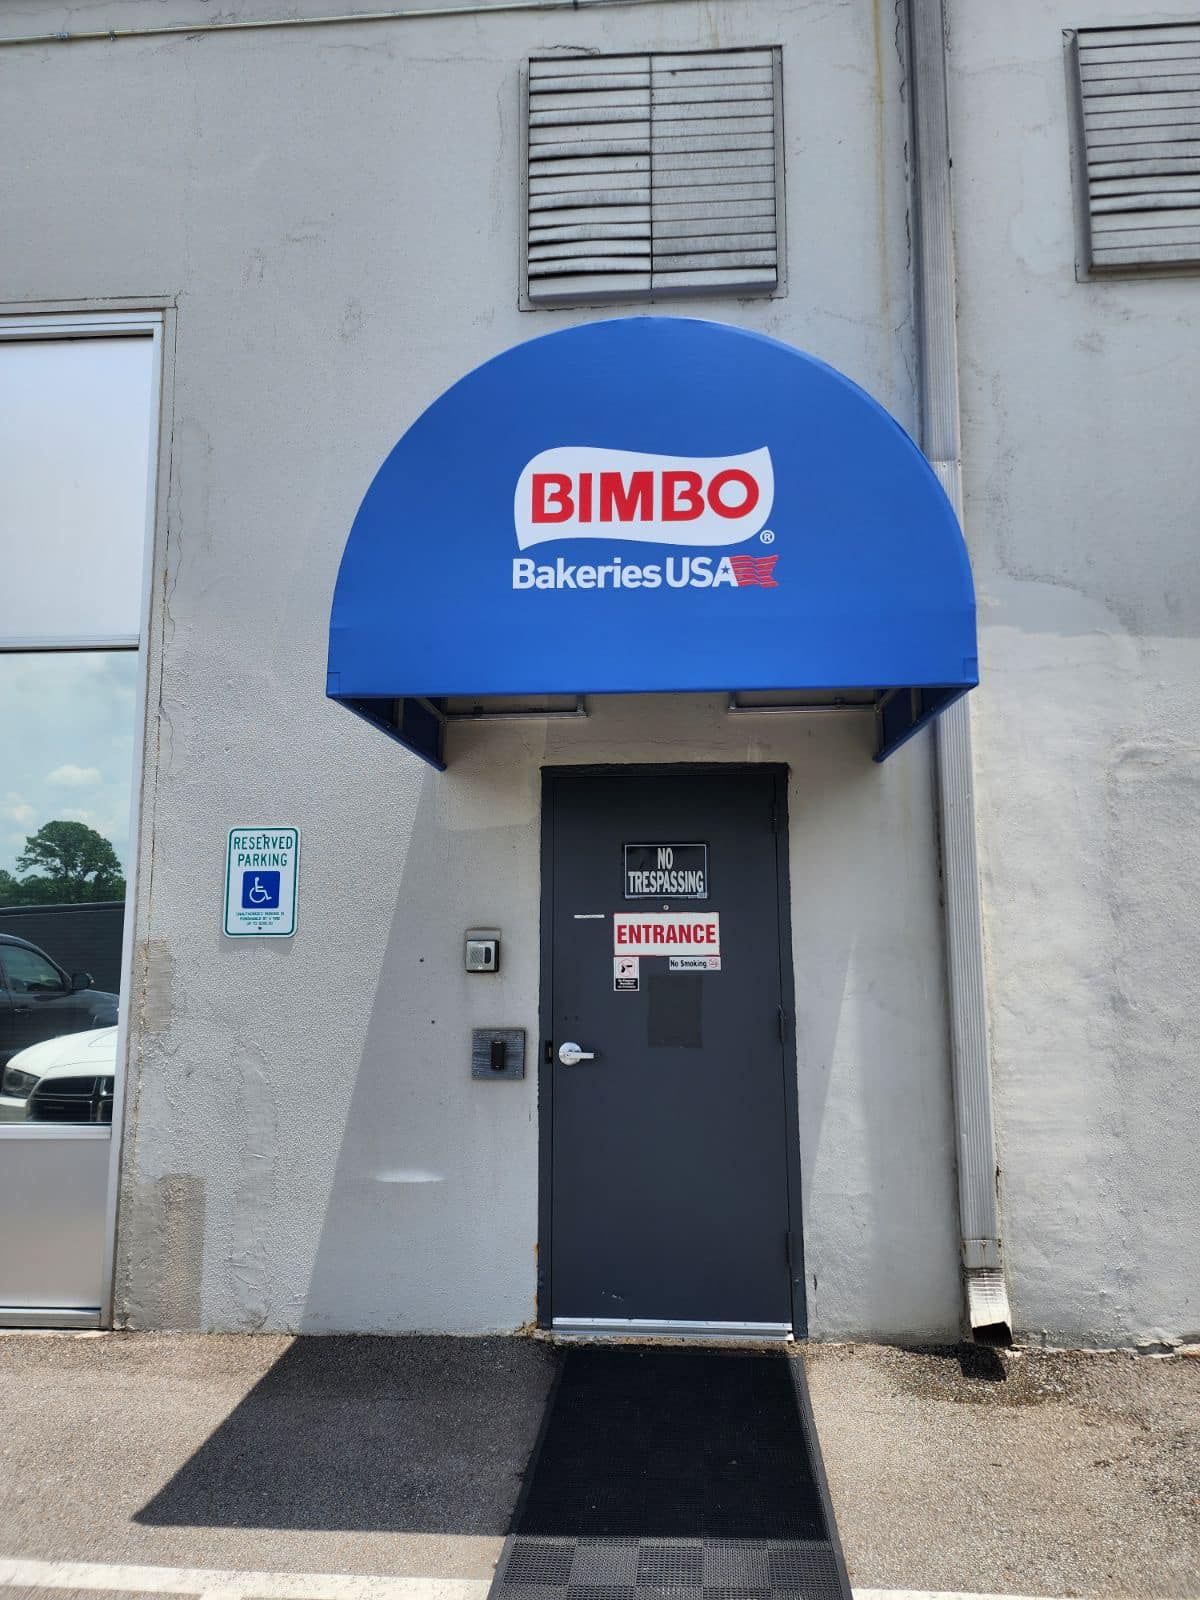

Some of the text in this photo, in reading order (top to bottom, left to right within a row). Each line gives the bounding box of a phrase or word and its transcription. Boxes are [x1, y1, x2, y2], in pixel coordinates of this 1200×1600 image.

[532, 469, 759, 523] BIMBO
[512, 556, 738, 589] Bakeries USA
[234, 836, 293, 850] RESERVED
[238, 853, 288, 867] PARKING
[657, 848, 673, 869] NO
[628, 871, 703, 892] TRESPASSING
[617, 924, 716, 944] ENTRANCE
[680, 960, 707, 968] Smoking
